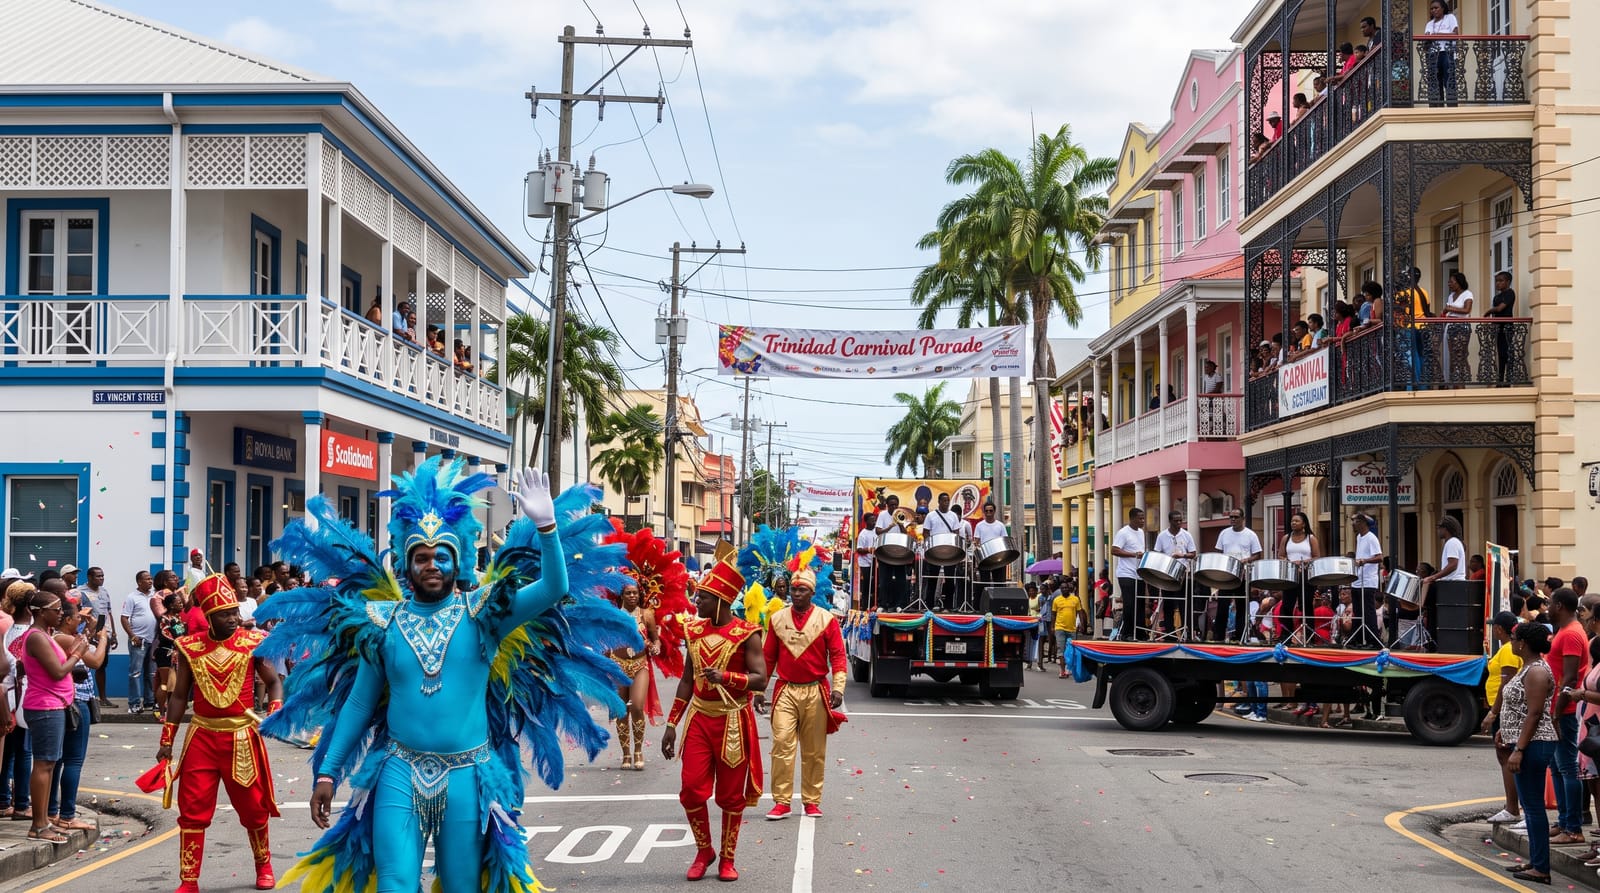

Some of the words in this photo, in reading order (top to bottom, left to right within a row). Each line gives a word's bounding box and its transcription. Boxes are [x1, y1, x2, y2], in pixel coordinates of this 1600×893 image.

[763, 333, 837, 355] Trinidad
[841, 336, 916, 358] Carnival
[919, 335, 983, 357] Parade
[1283, 356, 1327, 392] CARNIVAL
[95, 392, 106, 402] ST.
[107, 392, 136, 402] VINCENT
[137, 392, 163, 402] STREET
[254, 441, 275, 460] ROYAL
[275, 444, 293, 463] BANK
[335, 444, 374, 470] Scotiabank
[1346, 485, 1411, 494] RESTAURNT
